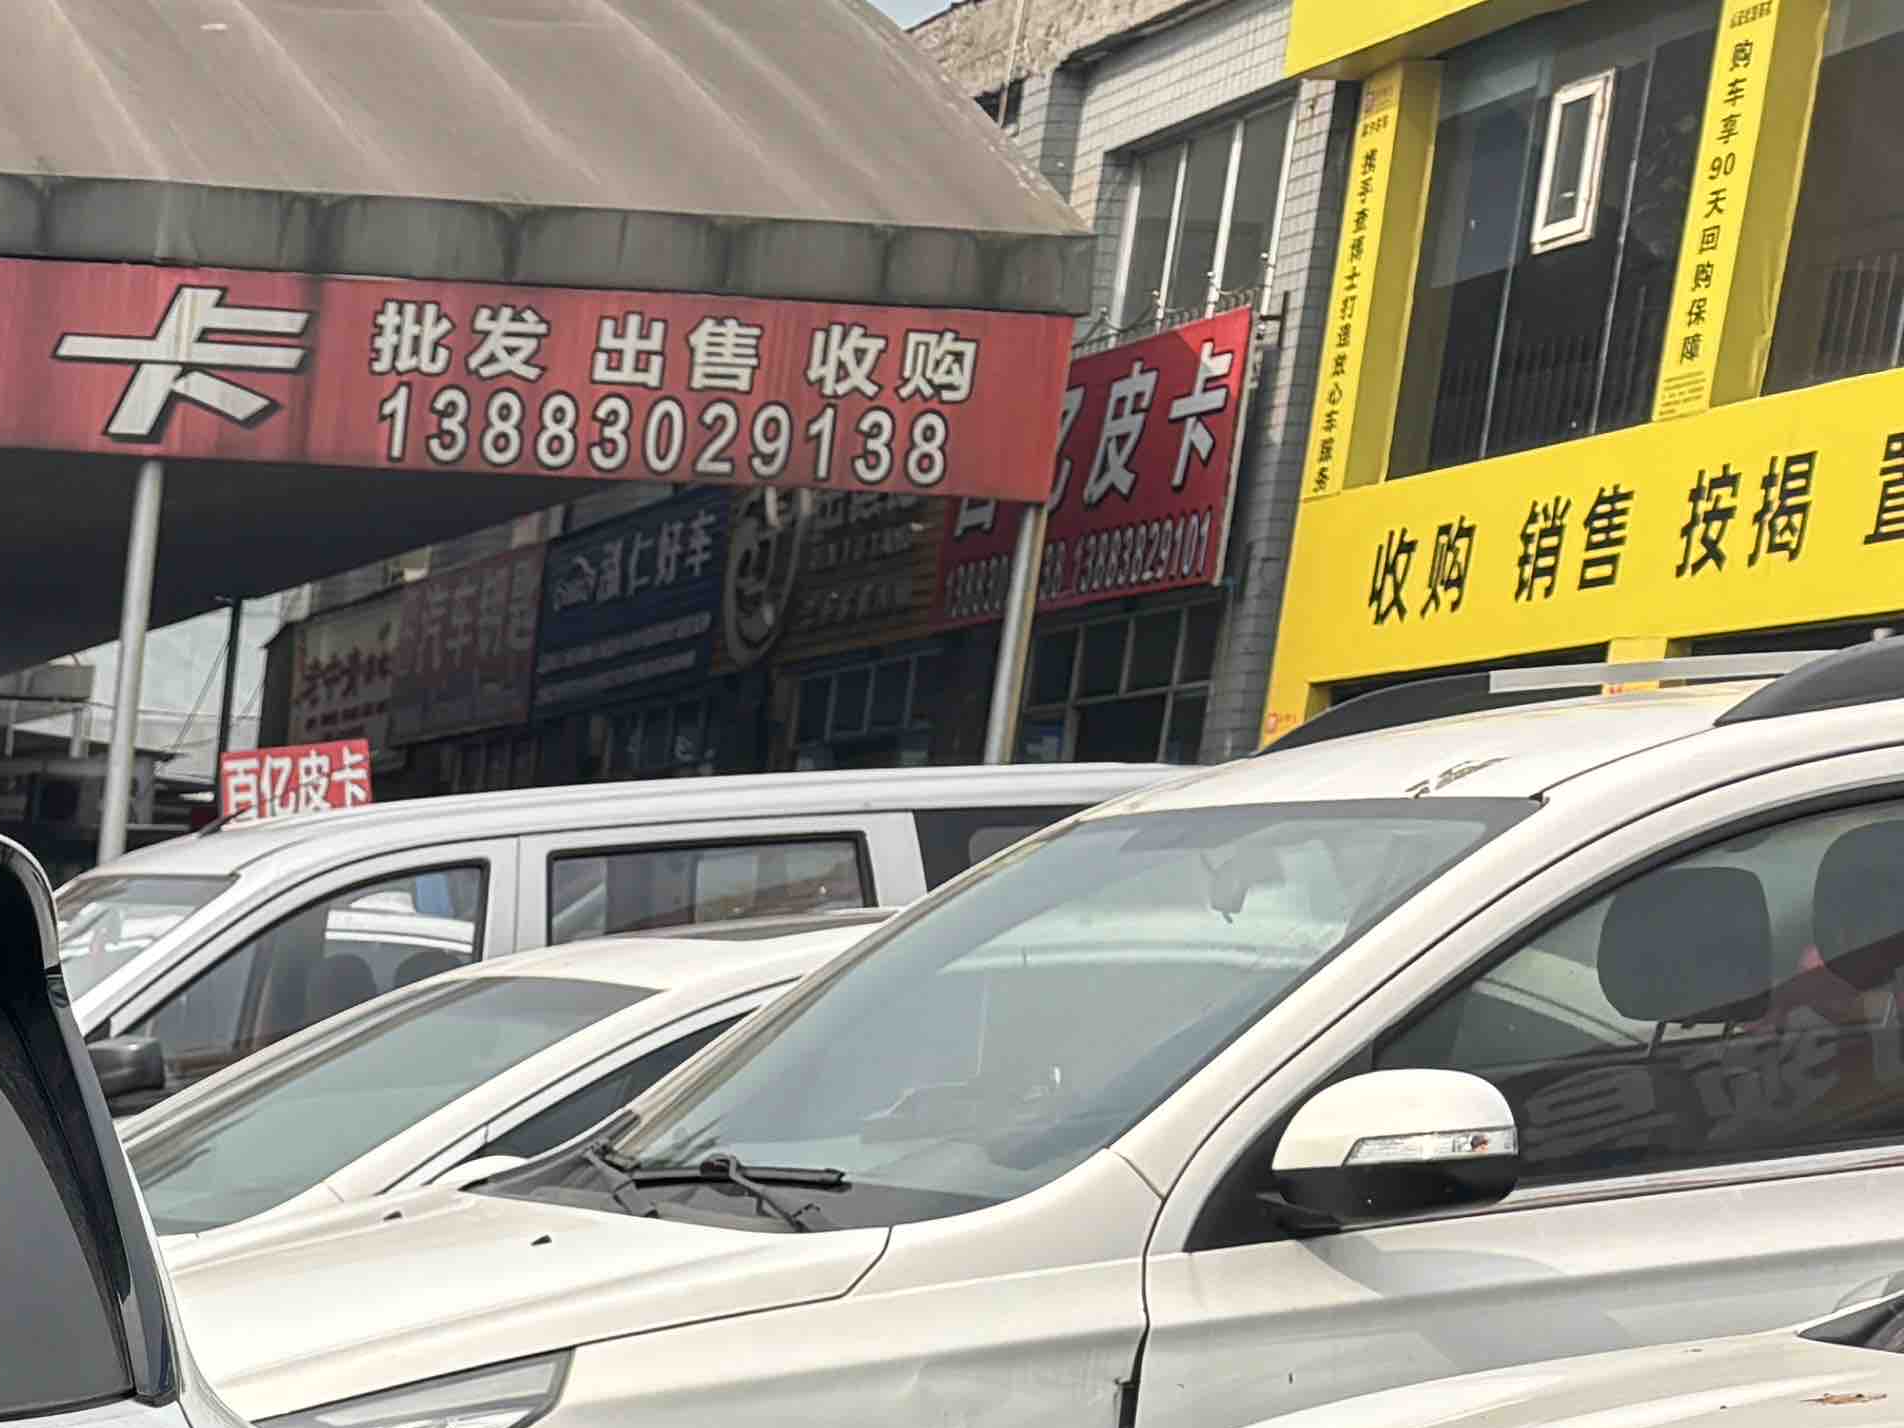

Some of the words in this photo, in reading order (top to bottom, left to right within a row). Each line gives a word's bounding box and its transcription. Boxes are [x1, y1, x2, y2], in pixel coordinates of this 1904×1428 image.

[370, 300, 550, 382] 批发
[592, 312, 763, 394] 出售
[806, 323, 979, 402] 收购
[378, 382, 951, 487] 13883029138
[1366, 514, 1478, 626] 收购
[1513, 483, 1635, 603] 销售
[1675, 449, 1819, 580] 按揭
[222, 746, 370, 822] 百亿皮卡
